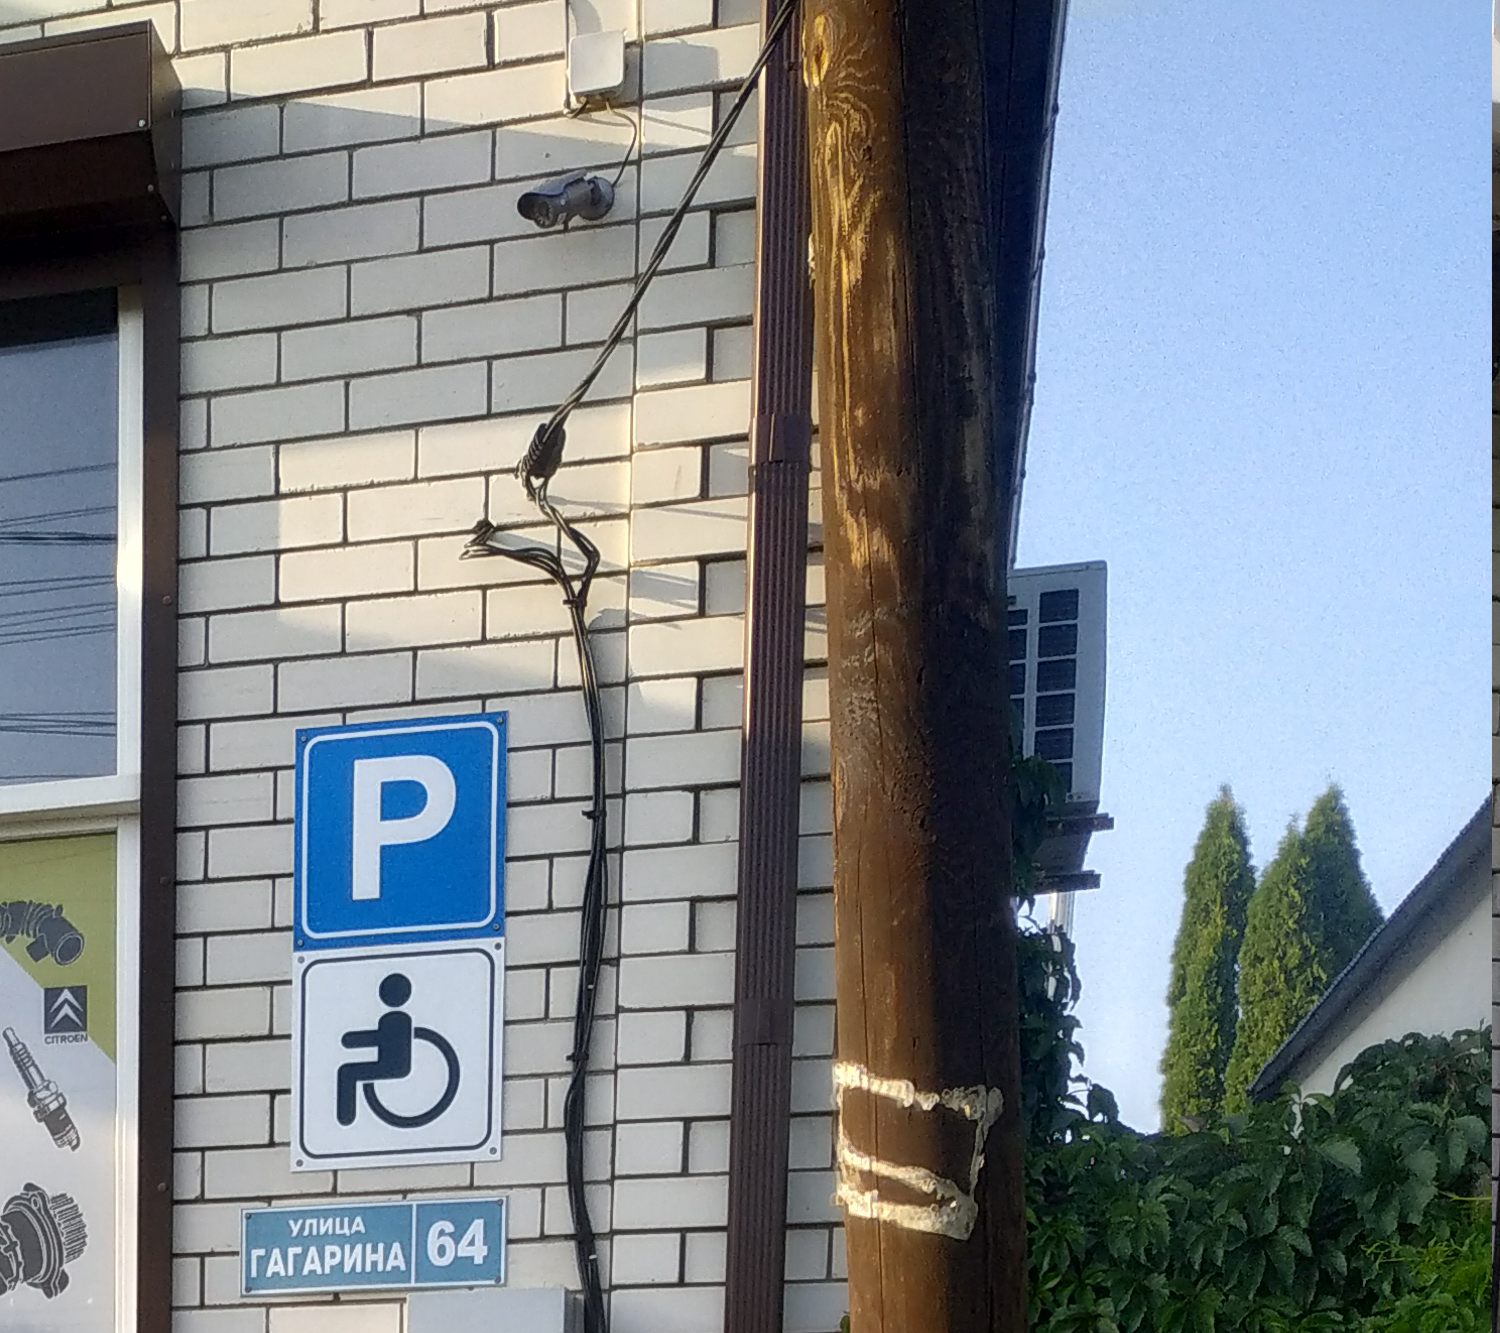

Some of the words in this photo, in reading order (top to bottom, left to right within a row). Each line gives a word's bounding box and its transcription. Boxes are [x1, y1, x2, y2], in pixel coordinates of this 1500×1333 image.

[352, 754, 457, 902] P
[44, 1033, 88, 1045] CITROEN
[288, 1215, 366, 1238] УЛИЦА
[426, 1217, 489, 1268] 64
[250, 1241, 407, 1279] ГАГАРИНА
